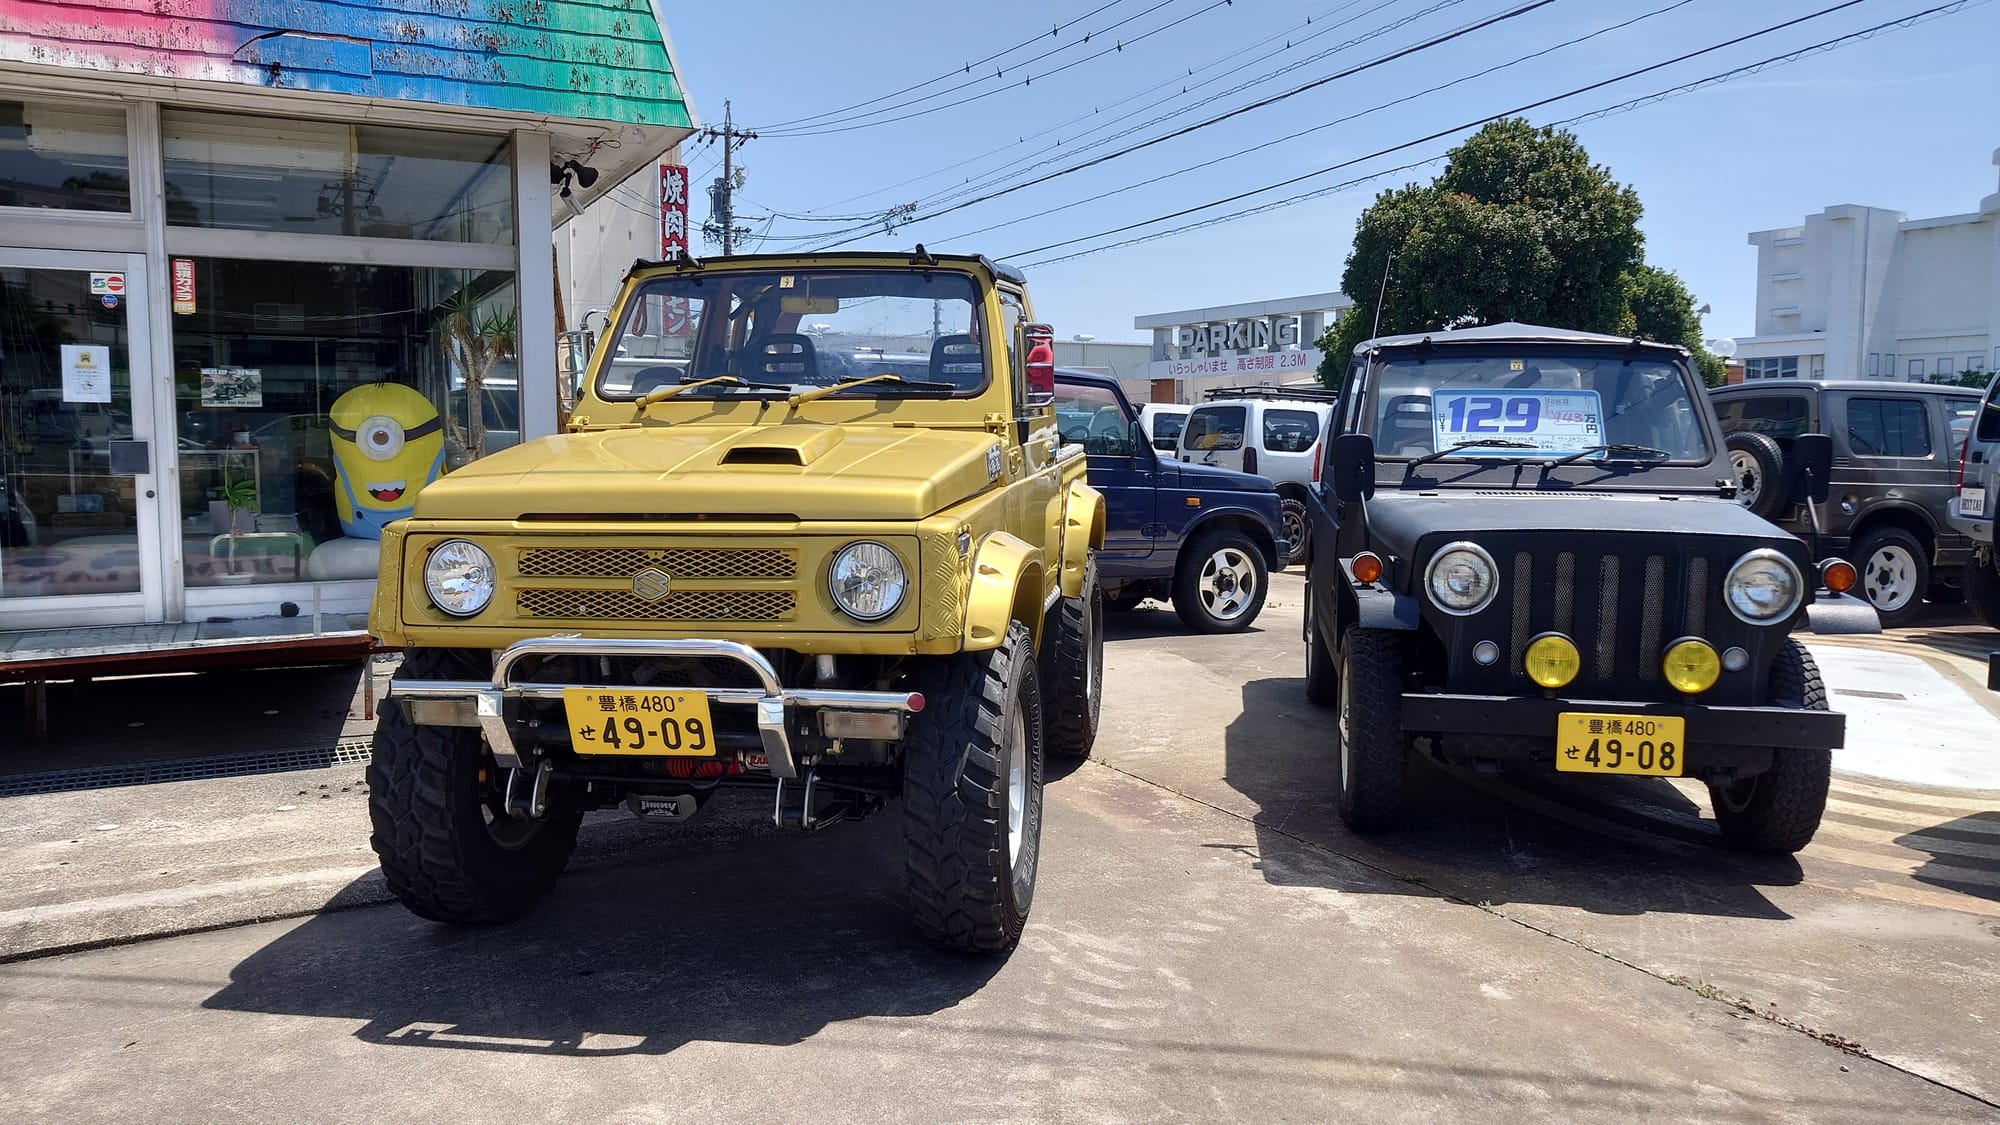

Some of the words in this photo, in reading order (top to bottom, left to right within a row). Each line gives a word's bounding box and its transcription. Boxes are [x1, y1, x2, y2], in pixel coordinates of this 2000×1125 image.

[1179, 318, 1297, 353] PARKING
[1168, 360, 1228, 375] いらっしゃいませ
[1237, 356, 1274, 371] 高さ制限
[1280, 353, 1307, 368] 2.3M
[1449, 396, 1541, 433] 129
[1584, 413, 1598, 434] 万円
[602, 716, 706, 750] 49-09
[1584, 738, 1675, 771] 49-08
